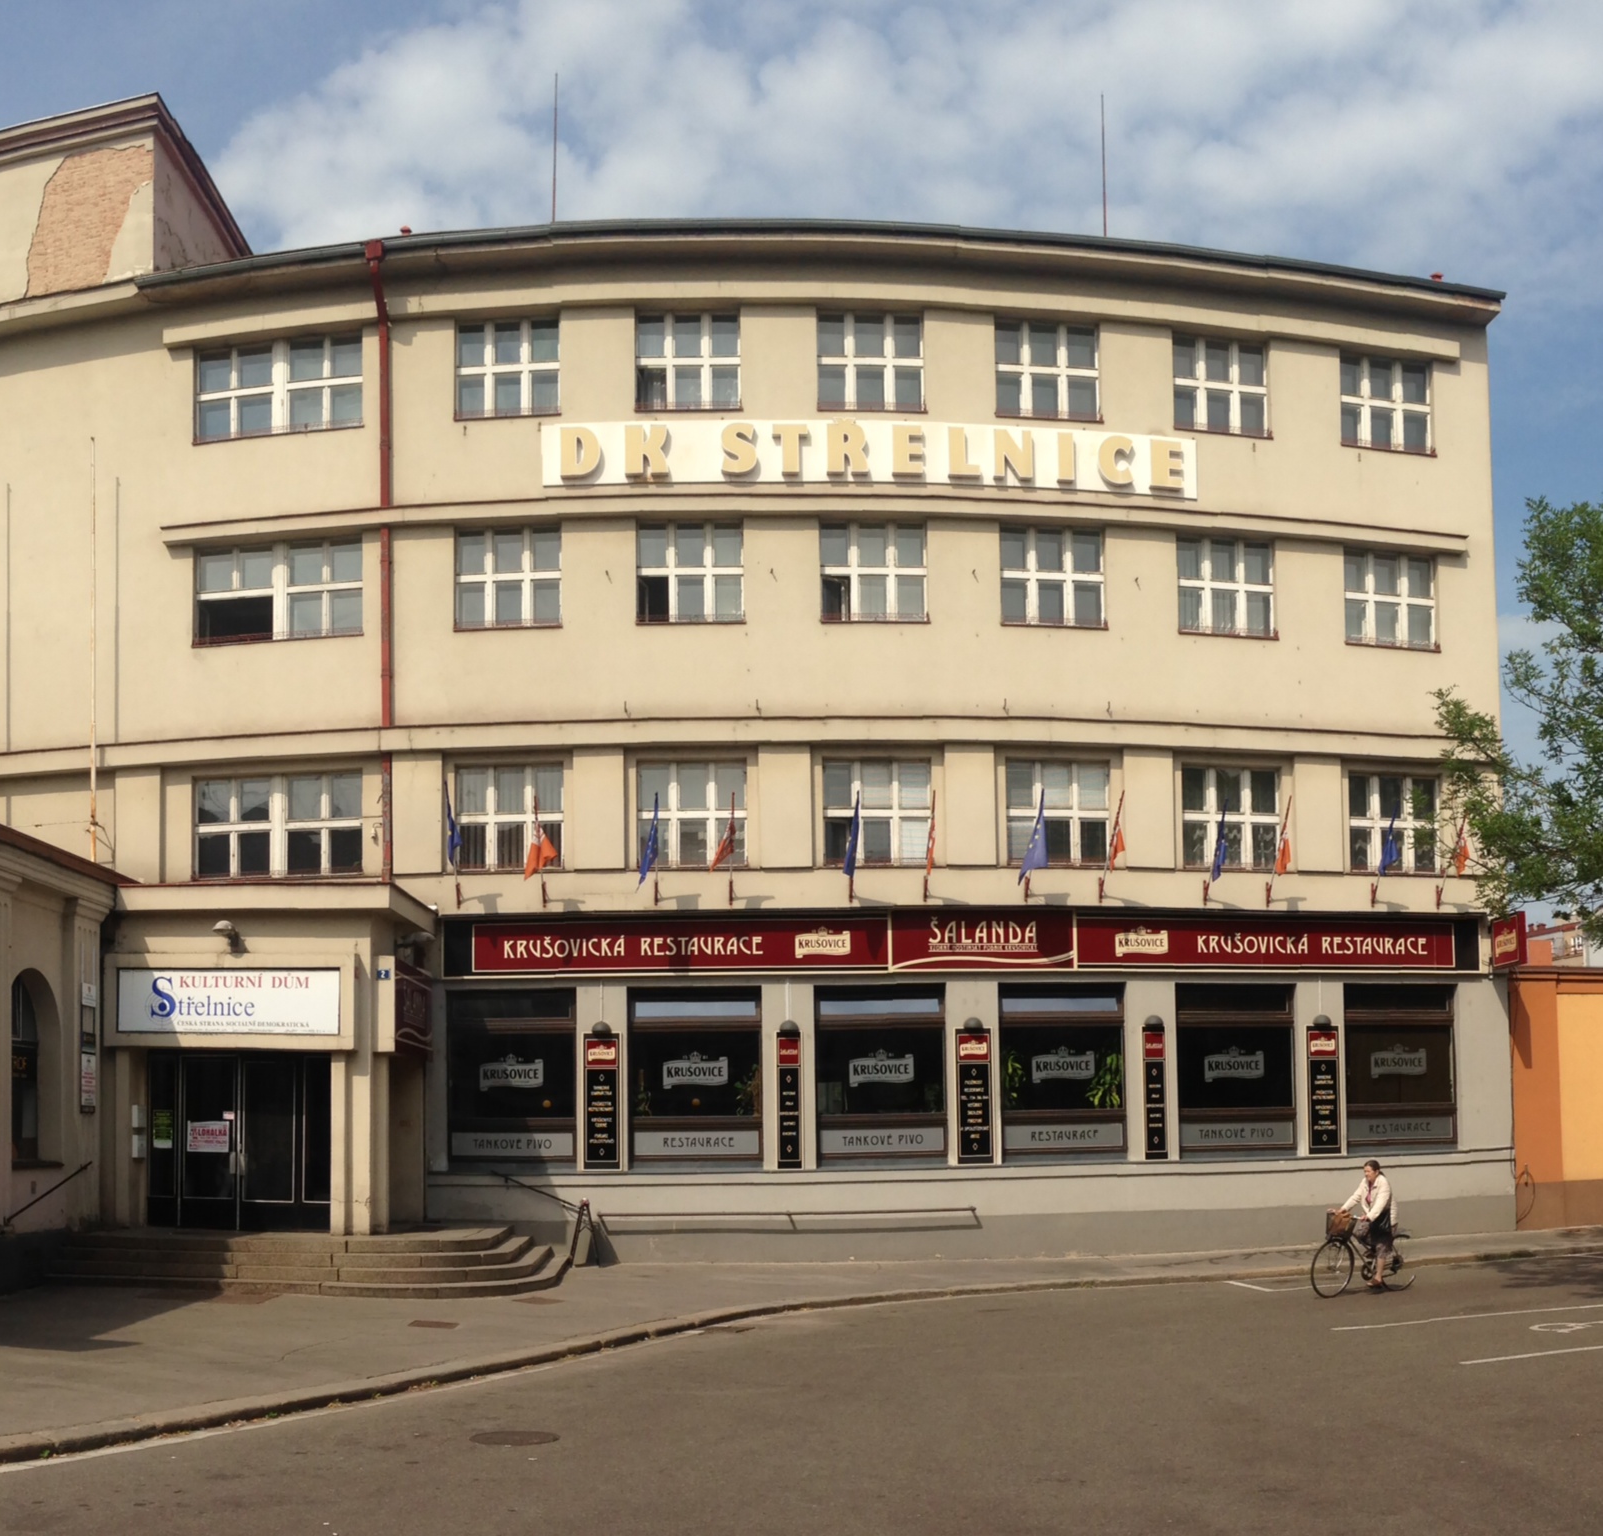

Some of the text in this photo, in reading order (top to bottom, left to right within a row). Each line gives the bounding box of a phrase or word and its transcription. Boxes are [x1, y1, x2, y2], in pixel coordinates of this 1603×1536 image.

[559, 416, 1186, 490] DK STŘELNICE
[928, 916, 1037, 944] ŠALANDA
[503, 935, 764, 959] KRUŠOVICKÁ RESTAURACE
[1197, 932, 1428, 955] KRUŠOVICKÁ RESTAURACE
[179, 973, 310, 989] KULTURNÍ DŮM
[150, 976, 255, 1018] Střelnice
[1199, 1126, 1275, 1140] TANKOVÉ PIVO
[1369, 1121, 1432, 1134] RESTAURACE
[473, 1136, 553, 1150] TANKOVÉ PIVO
[662, 1136, 735, 1148] RESTAURACE
[842, 1133, 924, 1147] TANKOVÉ PIVO
